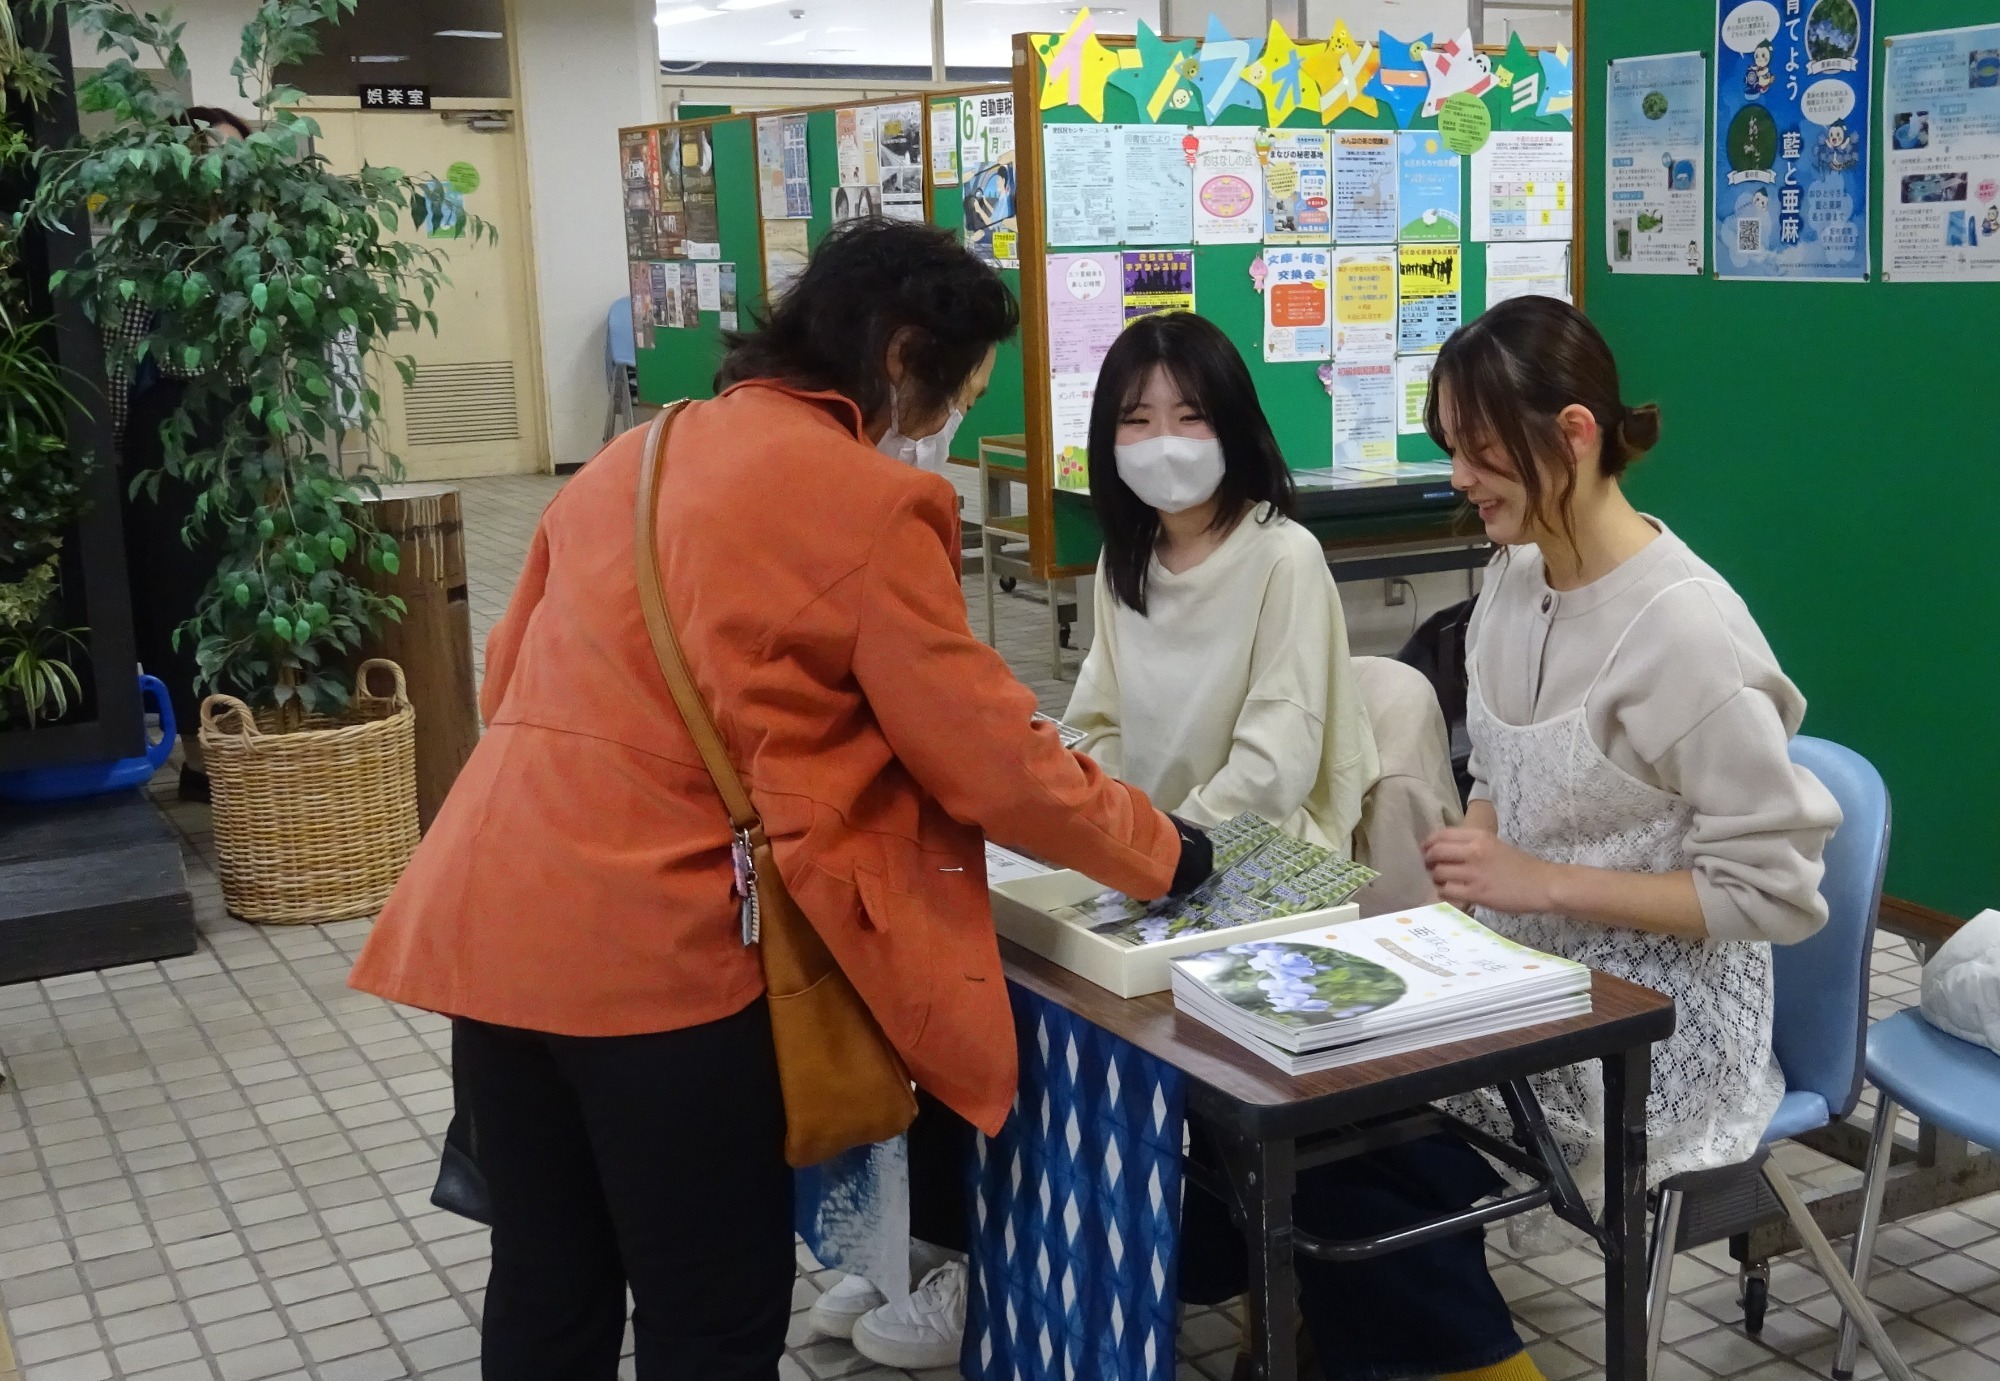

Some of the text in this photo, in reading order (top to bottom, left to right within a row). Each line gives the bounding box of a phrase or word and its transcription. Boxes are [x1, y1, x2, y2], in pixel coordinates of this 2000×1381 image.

[366, 88, 425, 106] 娯楽室
[980, 97, 1013, 118] 自動車税
[1202, 154, 1254, 168] おはなしの会
[1270, 150, 1324, 160] まなびの秘密基地
[1781, 131, 1801, 244] 藍と亜麻
[1267, 252, 1327, 267] 文庫・新書
[1277, 269, 1317, 281] 交換会
